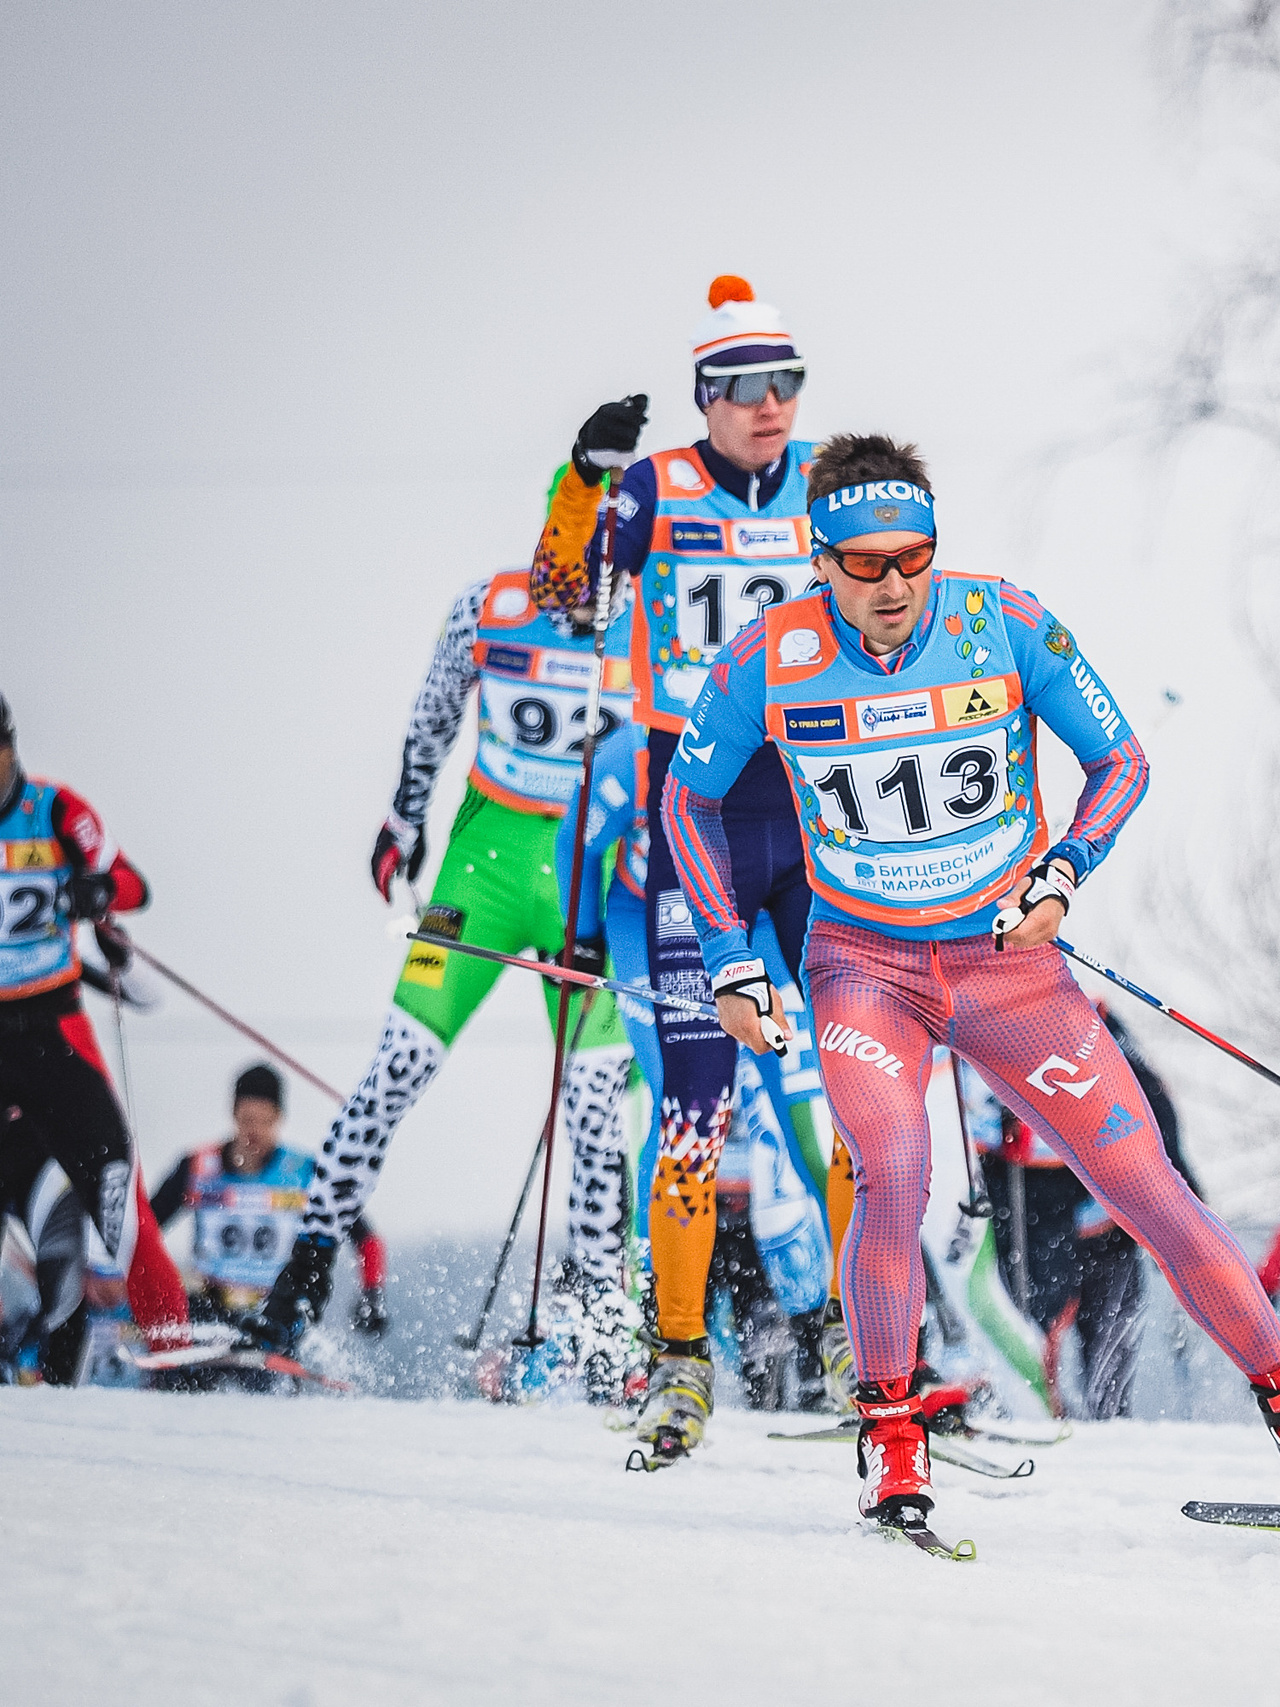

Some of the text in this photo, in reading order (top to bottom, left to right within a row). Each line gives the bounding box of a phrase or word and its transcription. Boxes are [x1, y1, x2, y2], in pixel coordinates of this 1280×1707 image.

[828, 482, 930, 512] LUKOIL
[688, 574, 819, 650] 13
[1070, 655, 1121, 741] LUKOIL
[813, 744, 999, 835] 113
[879, 841, 995, 878] БИТЦЕВСКИЙ
[882, 869, 972, 892] МАРАФОН
[0, 886, 50, 936] 2
[819, 1021, 905, 1078] LUKOIL
[869, 1403, 910, 1417] alpina
